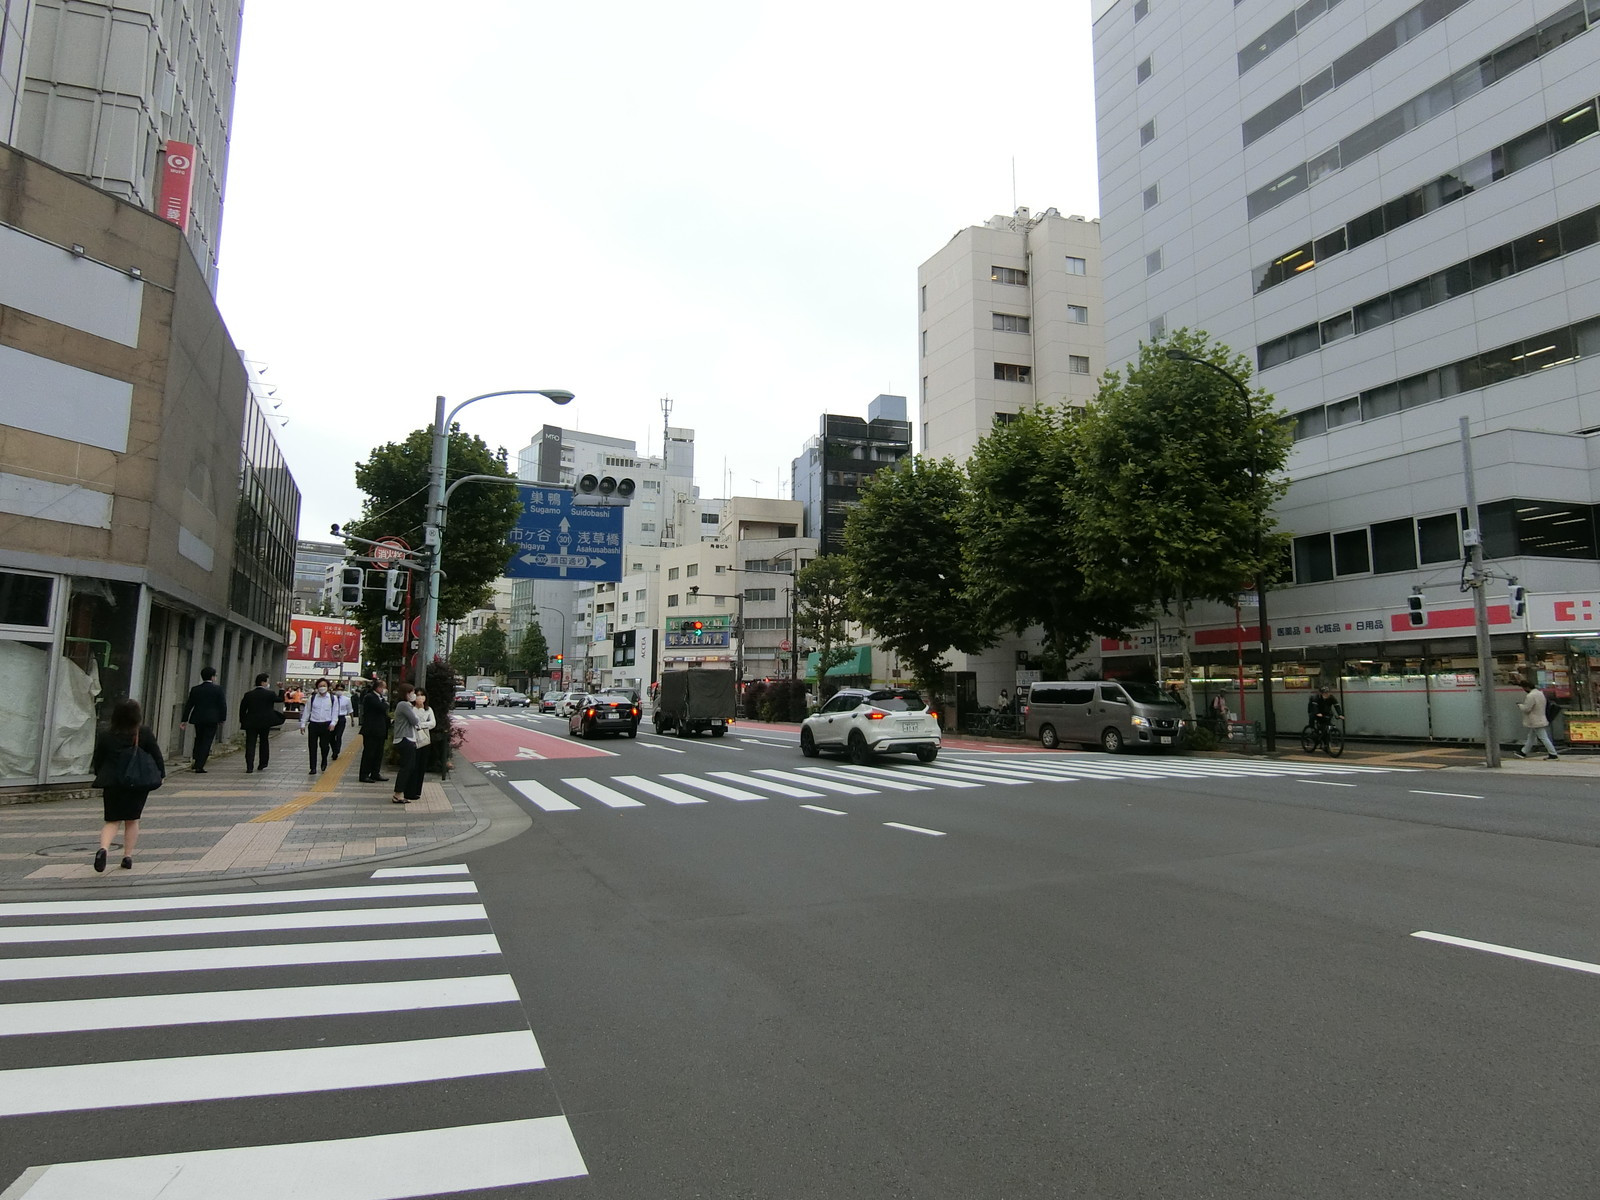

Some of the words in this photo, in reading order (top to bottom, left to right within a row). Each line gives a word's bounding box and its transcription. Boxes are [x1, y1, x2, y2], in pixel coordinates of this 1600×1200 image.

[530, 491, 561, 506] 巣鴨
[530, 505, 561, 515] Sugamo
[570, 508, 611, 518] Suidobashi
[577, 531, 620, 546] 浅草橋
[575, 545, 621, 555] Asakusabashi
[536, 556, 547, 564] 302
[550, 556, 585, 566] 靖国通り
[1277, 626, 1301, 637] 医薬品
[1315, 622, 1341, 634] 化粧品
[1356, 619, 1384, 631] 日用品
[669, 633, 724, 645] 集英社新書
